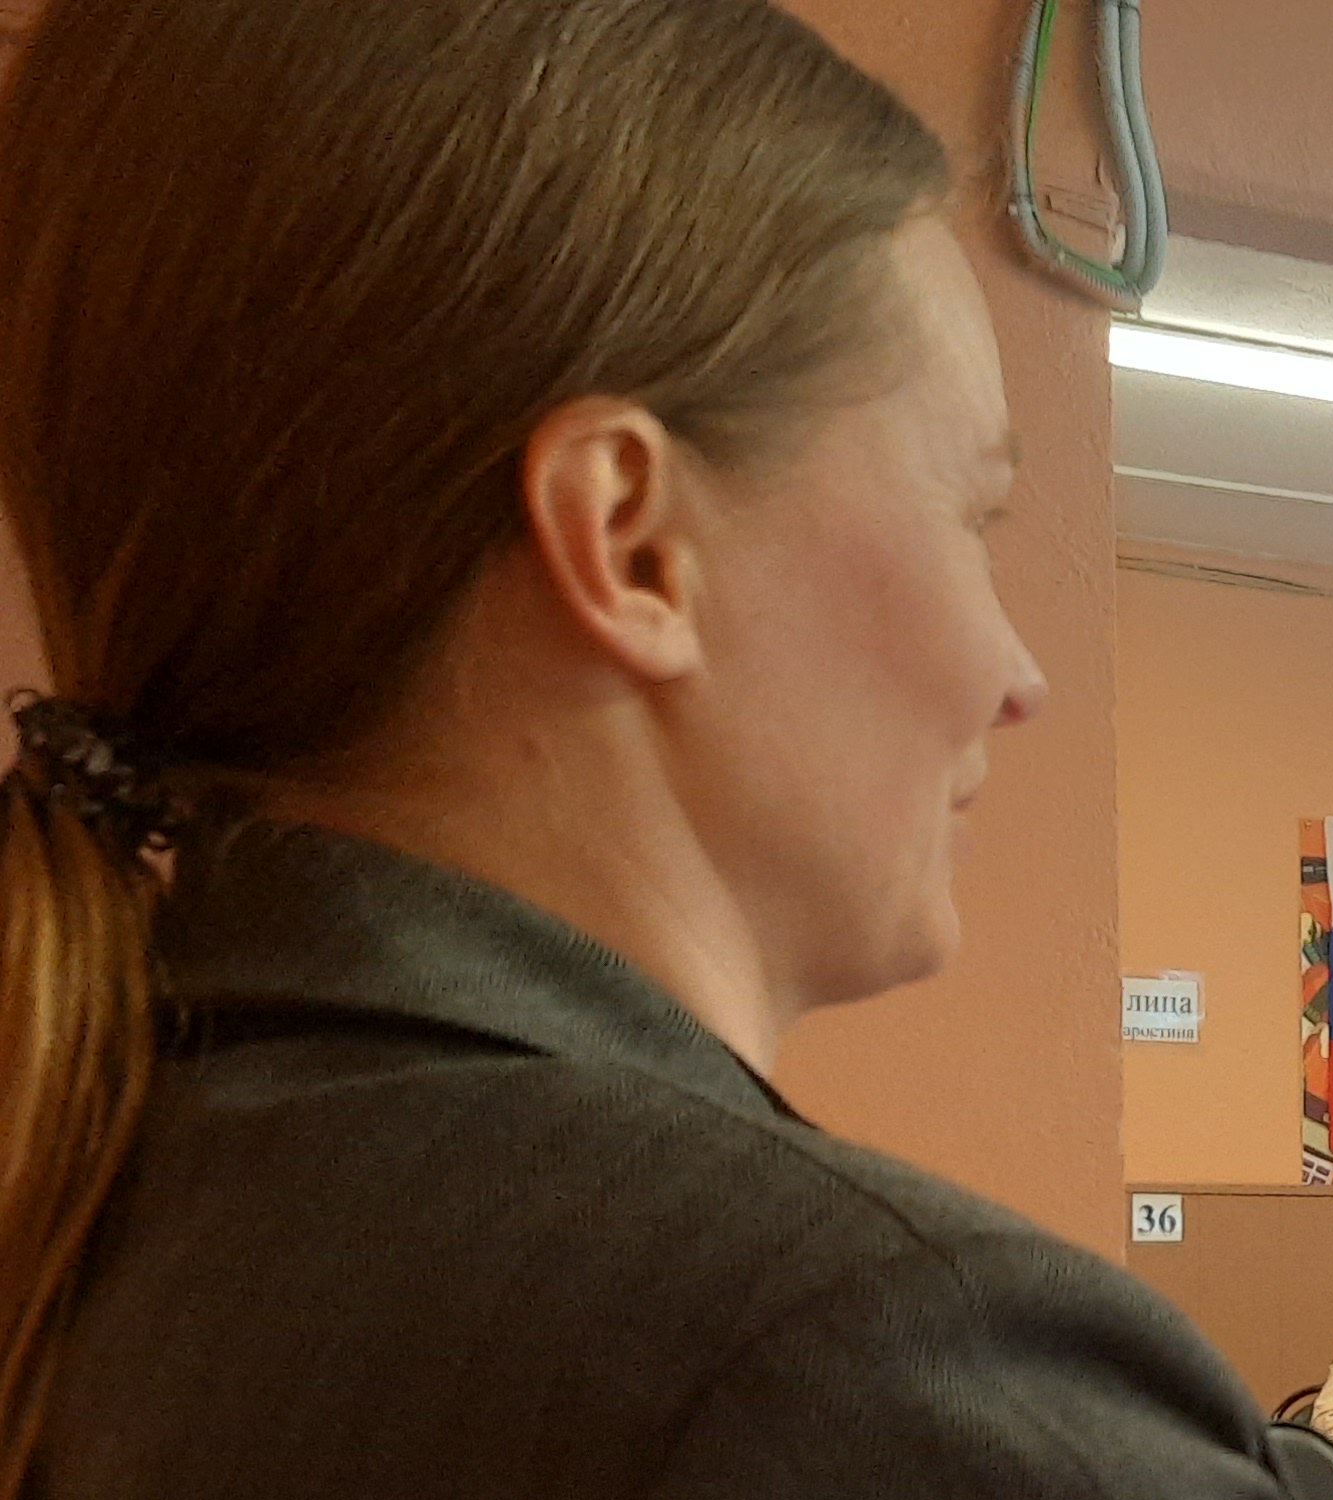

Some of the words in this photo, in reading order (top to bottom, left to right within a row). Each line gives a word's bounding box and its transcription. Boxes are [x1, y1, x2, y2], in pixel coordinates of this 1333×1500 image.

[1126, 994, 1193, 1017] лица
[1122, 1026, 1195, 1041] аростина
[1137, 1203, 1177, 1235] 36
